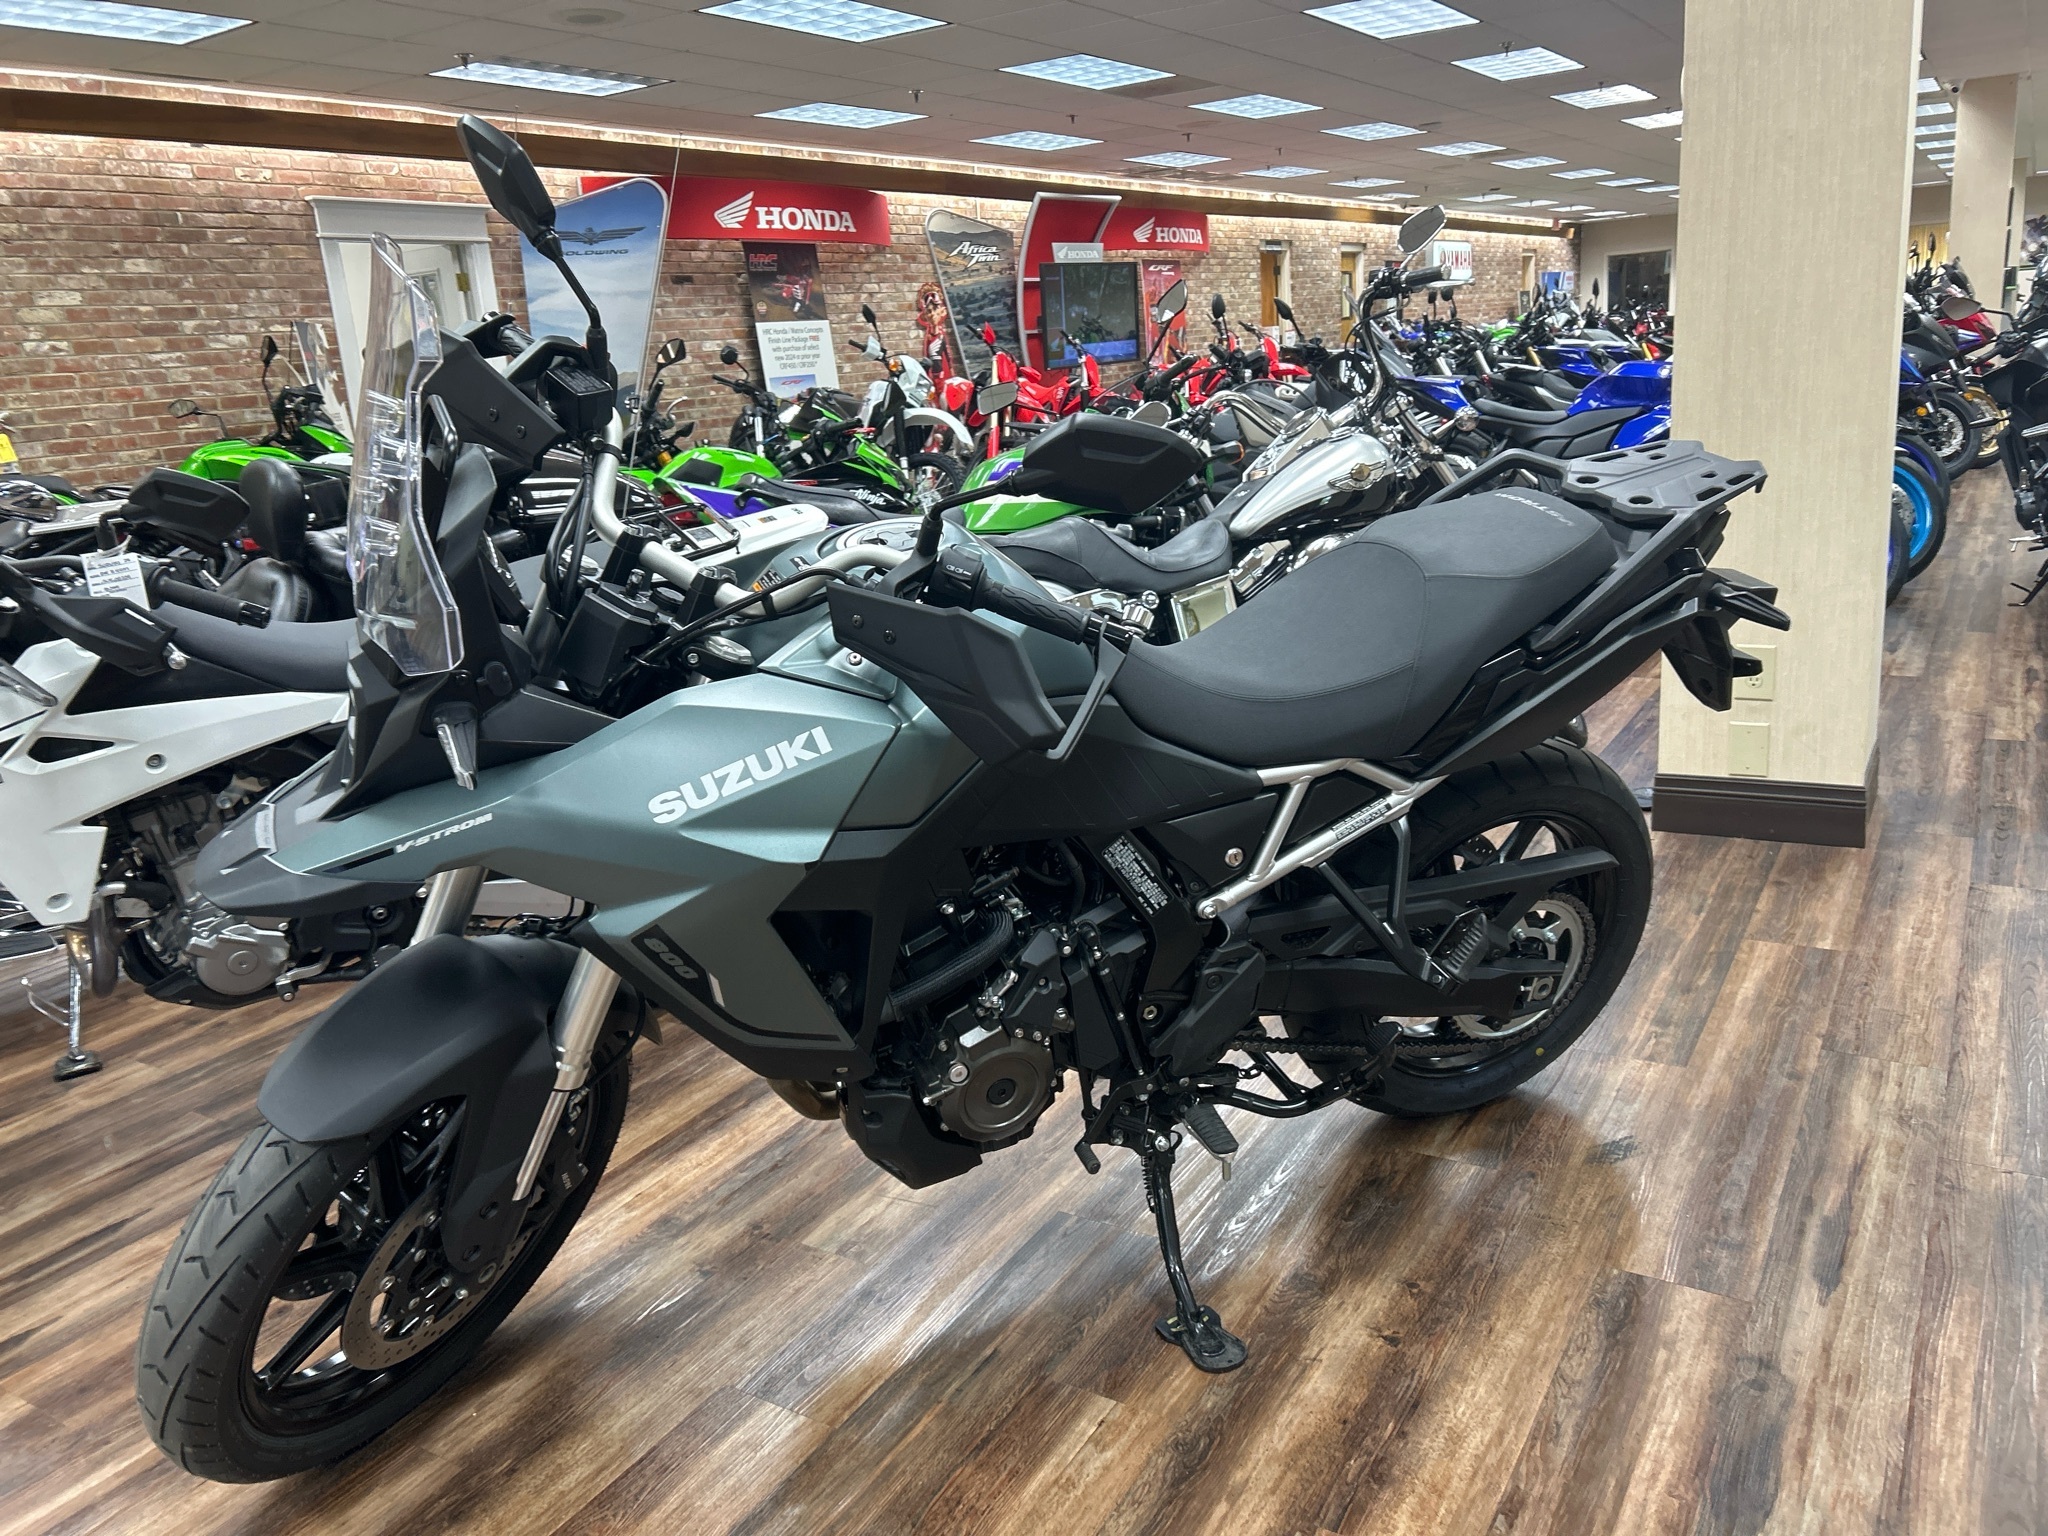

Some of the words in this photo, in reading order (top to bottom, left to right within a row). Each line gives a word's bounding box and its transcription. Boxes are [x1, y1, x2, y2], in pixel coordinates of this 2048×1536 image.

[754, 206, 857, 233] HONDA
[1155, 227, 1203, 244] HONDA
[563, 248, 629, 256] OLDWING
[948, 241, 1000, 257] Africa
[1068, 250, 1099, 259] HONDA
[749, 253, 778, 269] HRC
[966, 253, 1004, 268] Twin
[849, 488, 886, 505] Ninja
[647, 725, 833, 825] SUZUKI
[396, 812, 493, 853] V-STROM
[644, 938, 699, 979] 800
